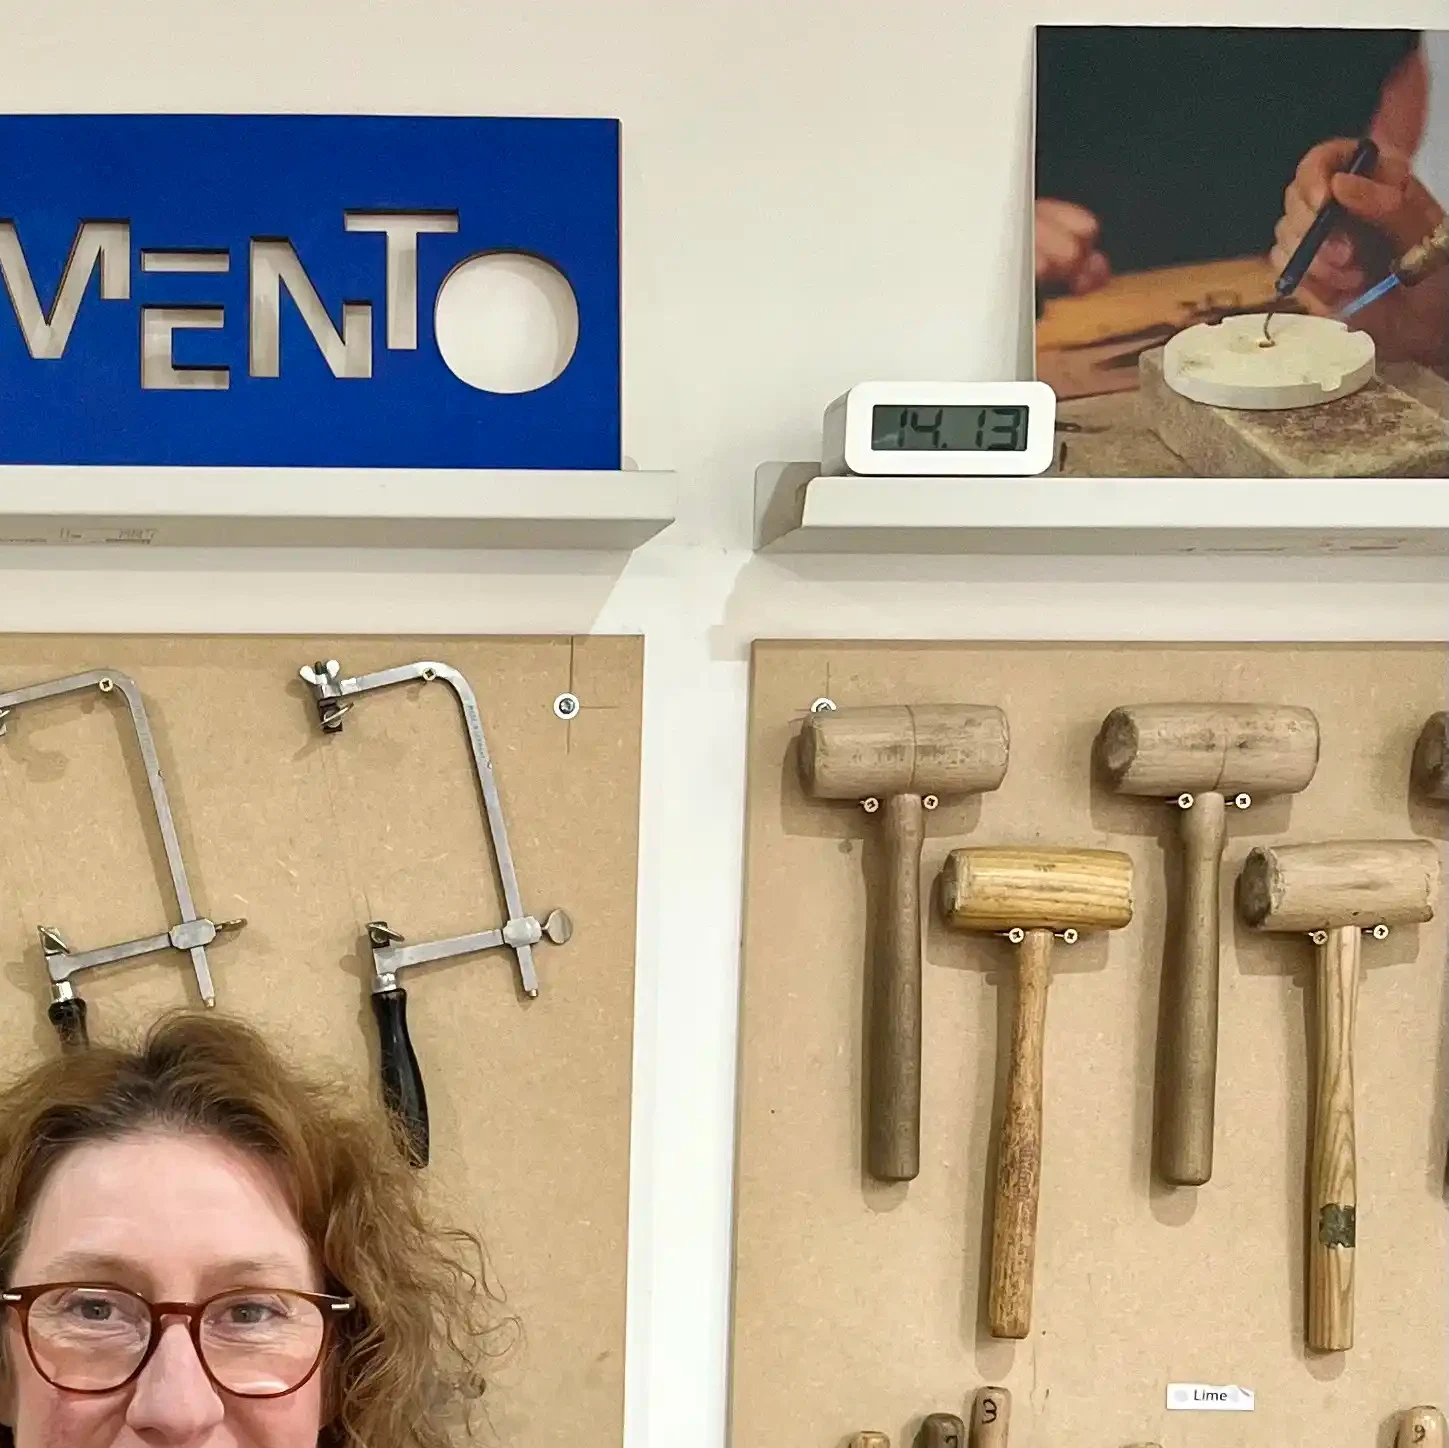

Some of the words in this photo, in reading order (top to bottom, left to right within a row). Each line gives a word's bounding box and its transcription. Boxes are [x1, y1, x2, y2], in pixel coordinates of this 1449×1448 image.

[1193, 1388, 1229, 1402] Lime
[981, 1397, 998, 1425] 3
[1412, 1423, 1426, 1444] 9
